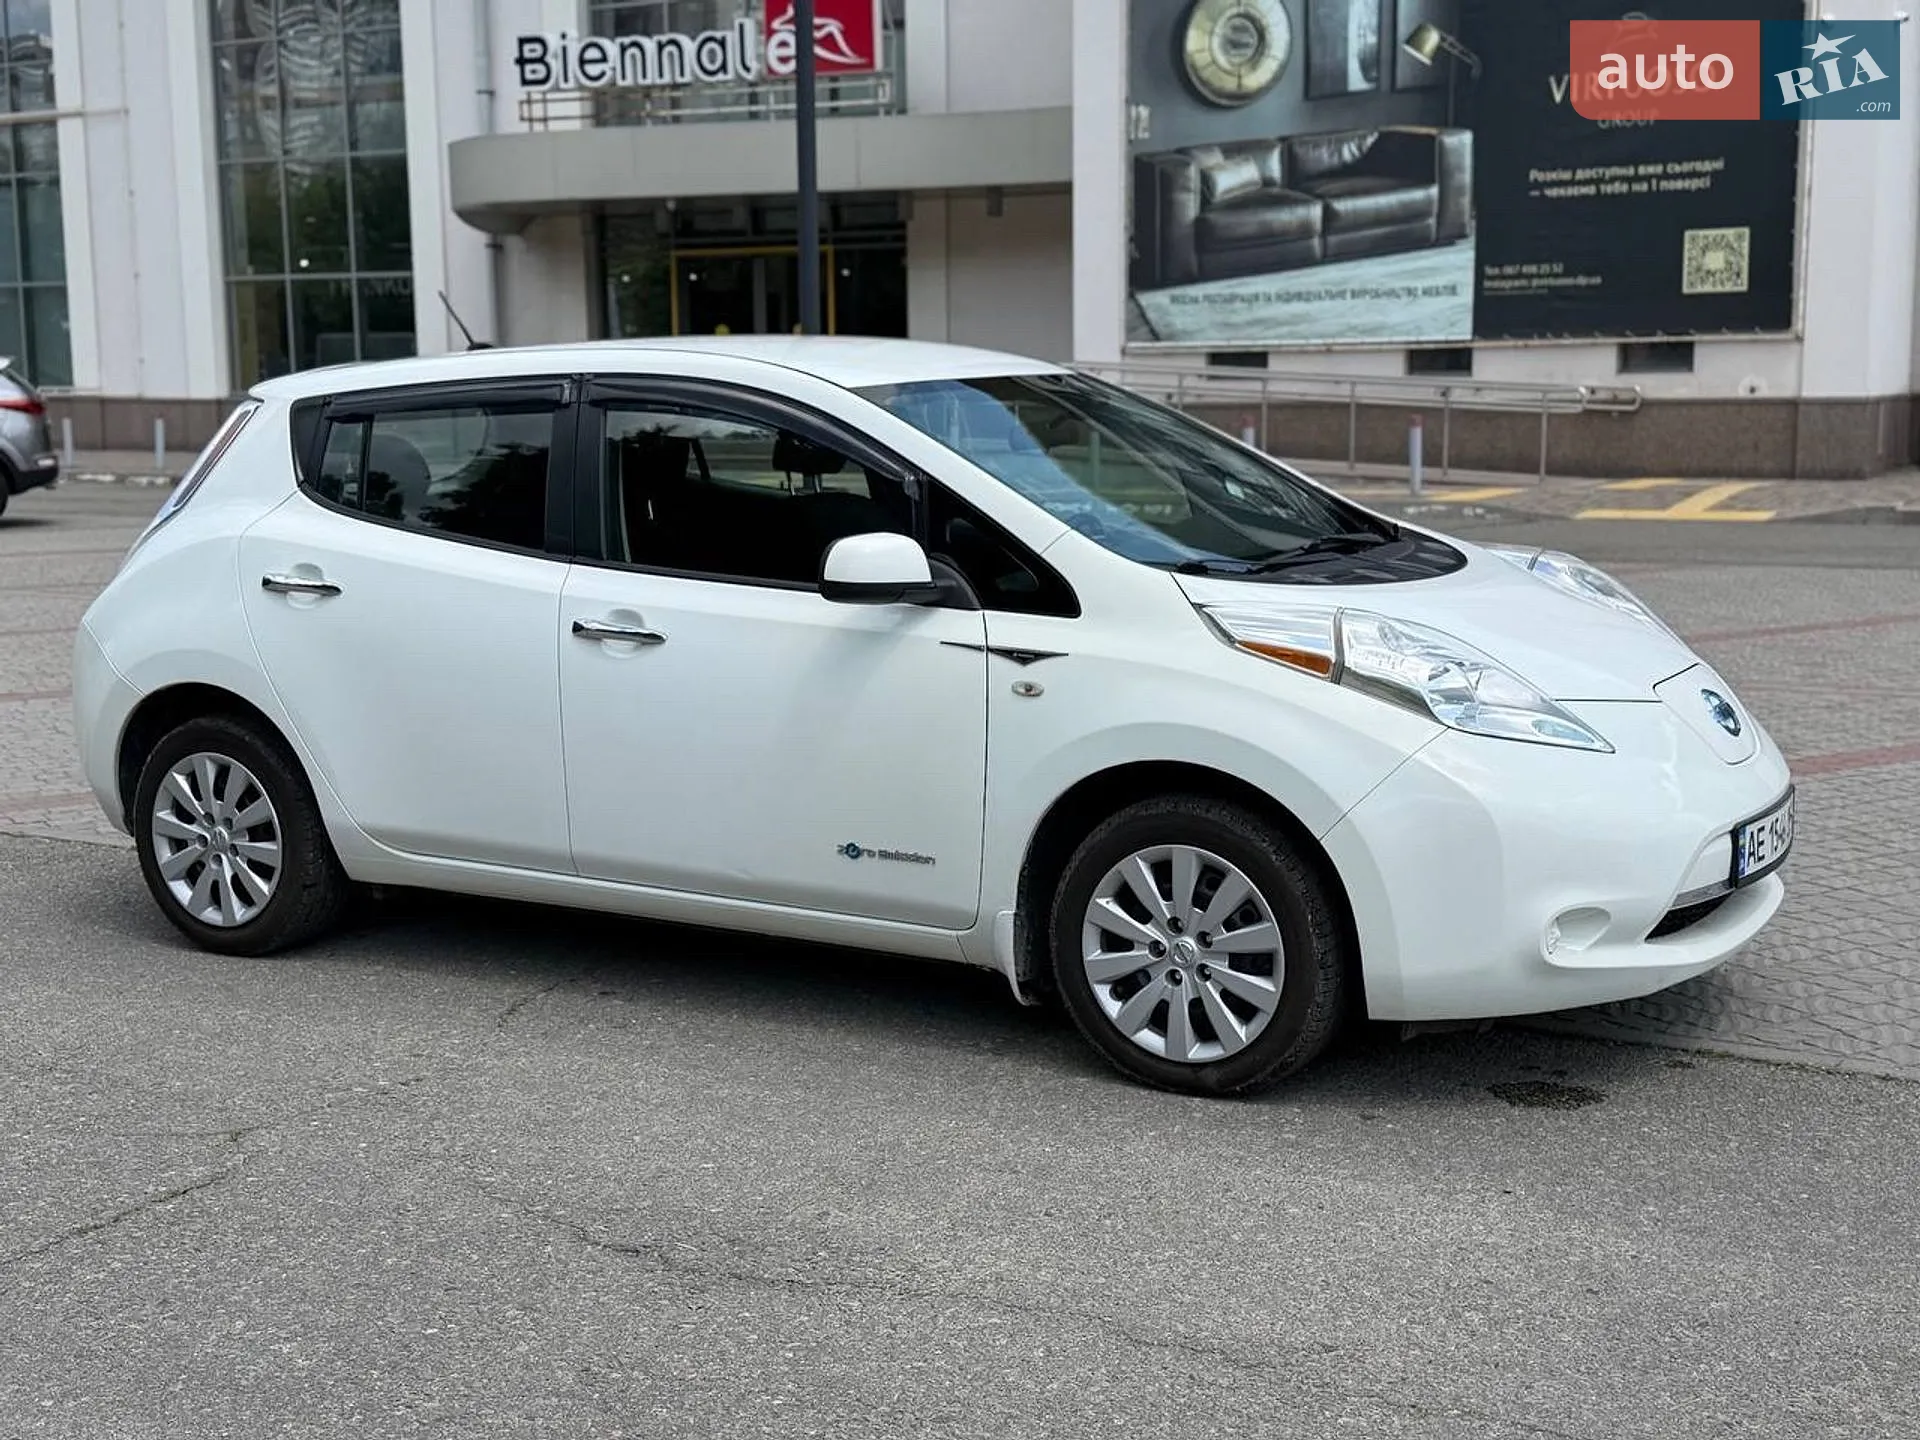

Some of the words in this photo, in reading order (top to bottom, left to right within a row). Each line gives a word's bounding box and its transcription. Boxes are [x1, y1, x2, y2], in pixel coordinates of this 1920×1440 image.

[1596, 107, 1660, 130] GROUP
[1574, 164, 1635, 181] доступна
[1666, 157, 1725, 174] сьогодні
[1631, 180, 1649, 193] на
[1746, 825, 1766, 868] AE
